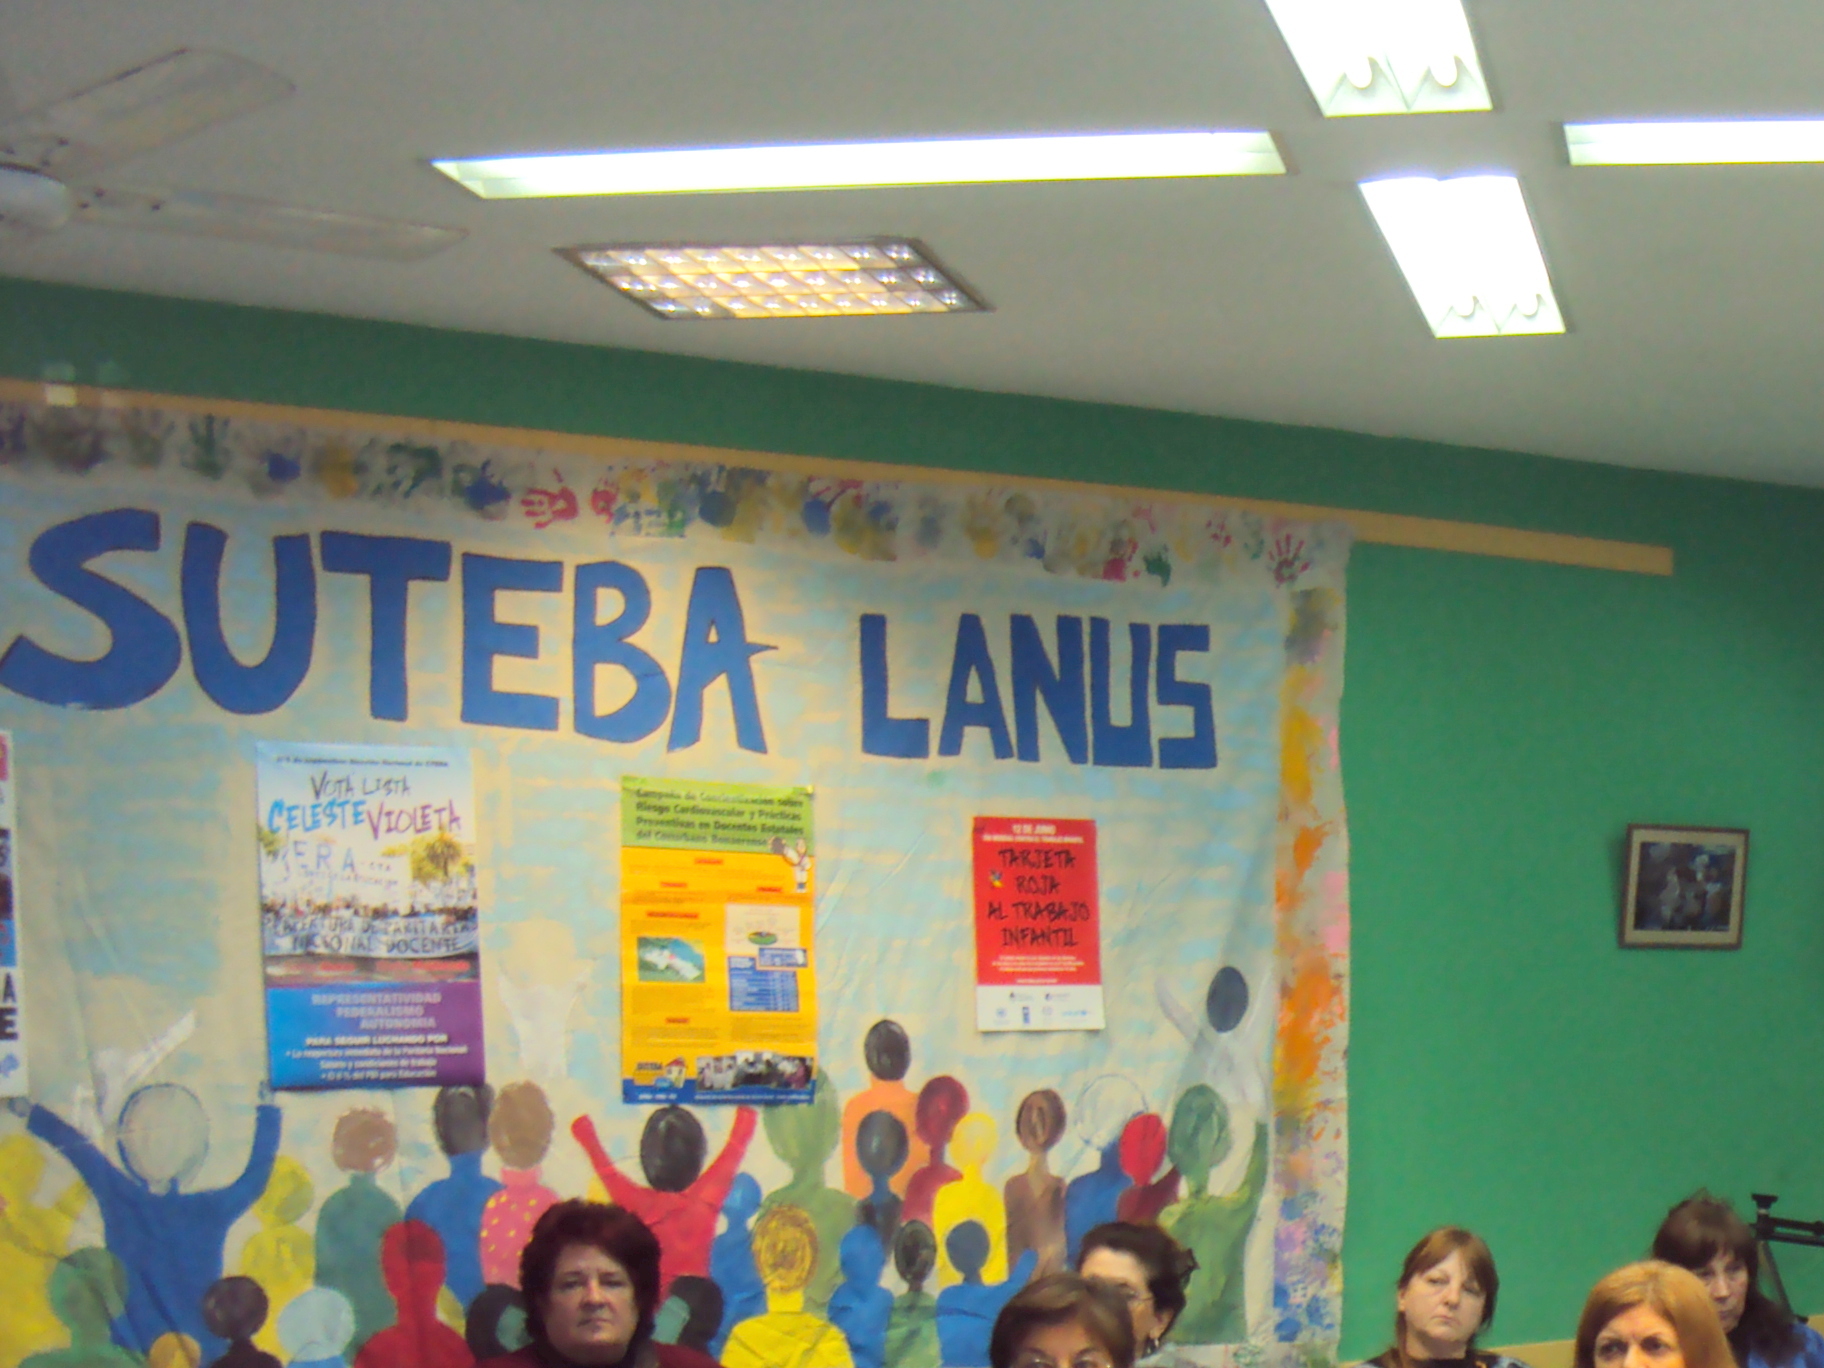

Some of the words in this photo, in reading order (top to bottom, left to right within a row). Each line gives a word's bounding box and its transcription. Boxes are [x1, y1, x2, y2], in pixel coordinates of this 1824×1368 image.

[0, 507, 779, 754] SUTEBA
[859, 613, 1217, 769] LANUS
[311, 770, 354, 800] VOTA
[362, 775, 411, 797] LISTA
[267, 798, 367, 834] CELESTE
[366, 799, 462, 841] VIOLETA
[998, 848, 1076, 869] TARJETA
[1016, 875, 1060, 895] ROJA
[987, 901, 1009, 920] AL
[1012, 901, 1090, 922] TRABAJO
[387, 938, 462, 954] DOCENTE
[1002, 926, 1078, 947] INFANTIL
